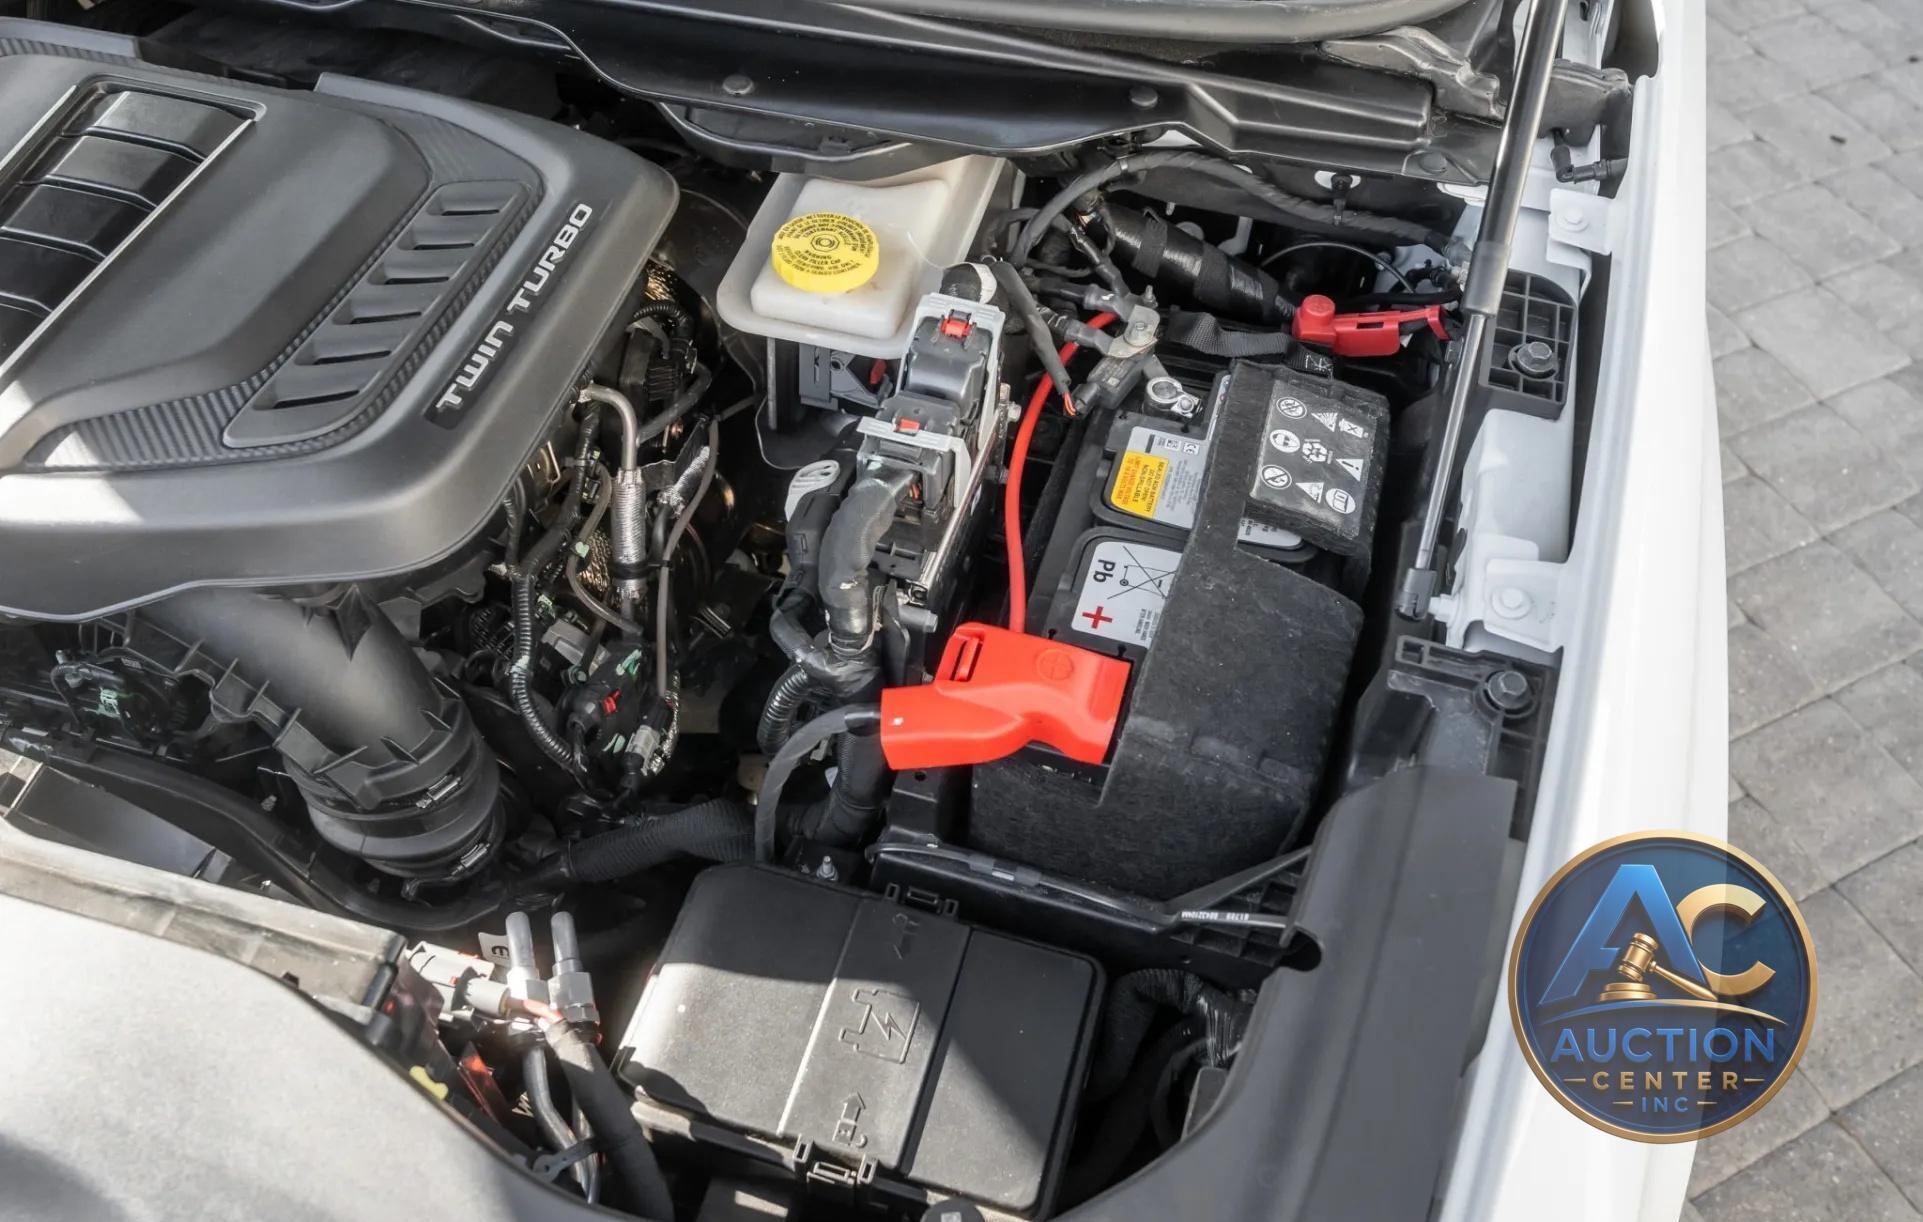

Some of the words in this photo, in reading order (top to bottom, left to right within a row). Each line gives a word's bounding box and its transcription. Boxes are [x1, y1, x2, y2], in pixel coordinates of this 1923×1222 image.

[436, 320, 514, 411] TWIN
[506, 203, 593, 314] TURBO
[1093, 559, 1115, 582] Pb
